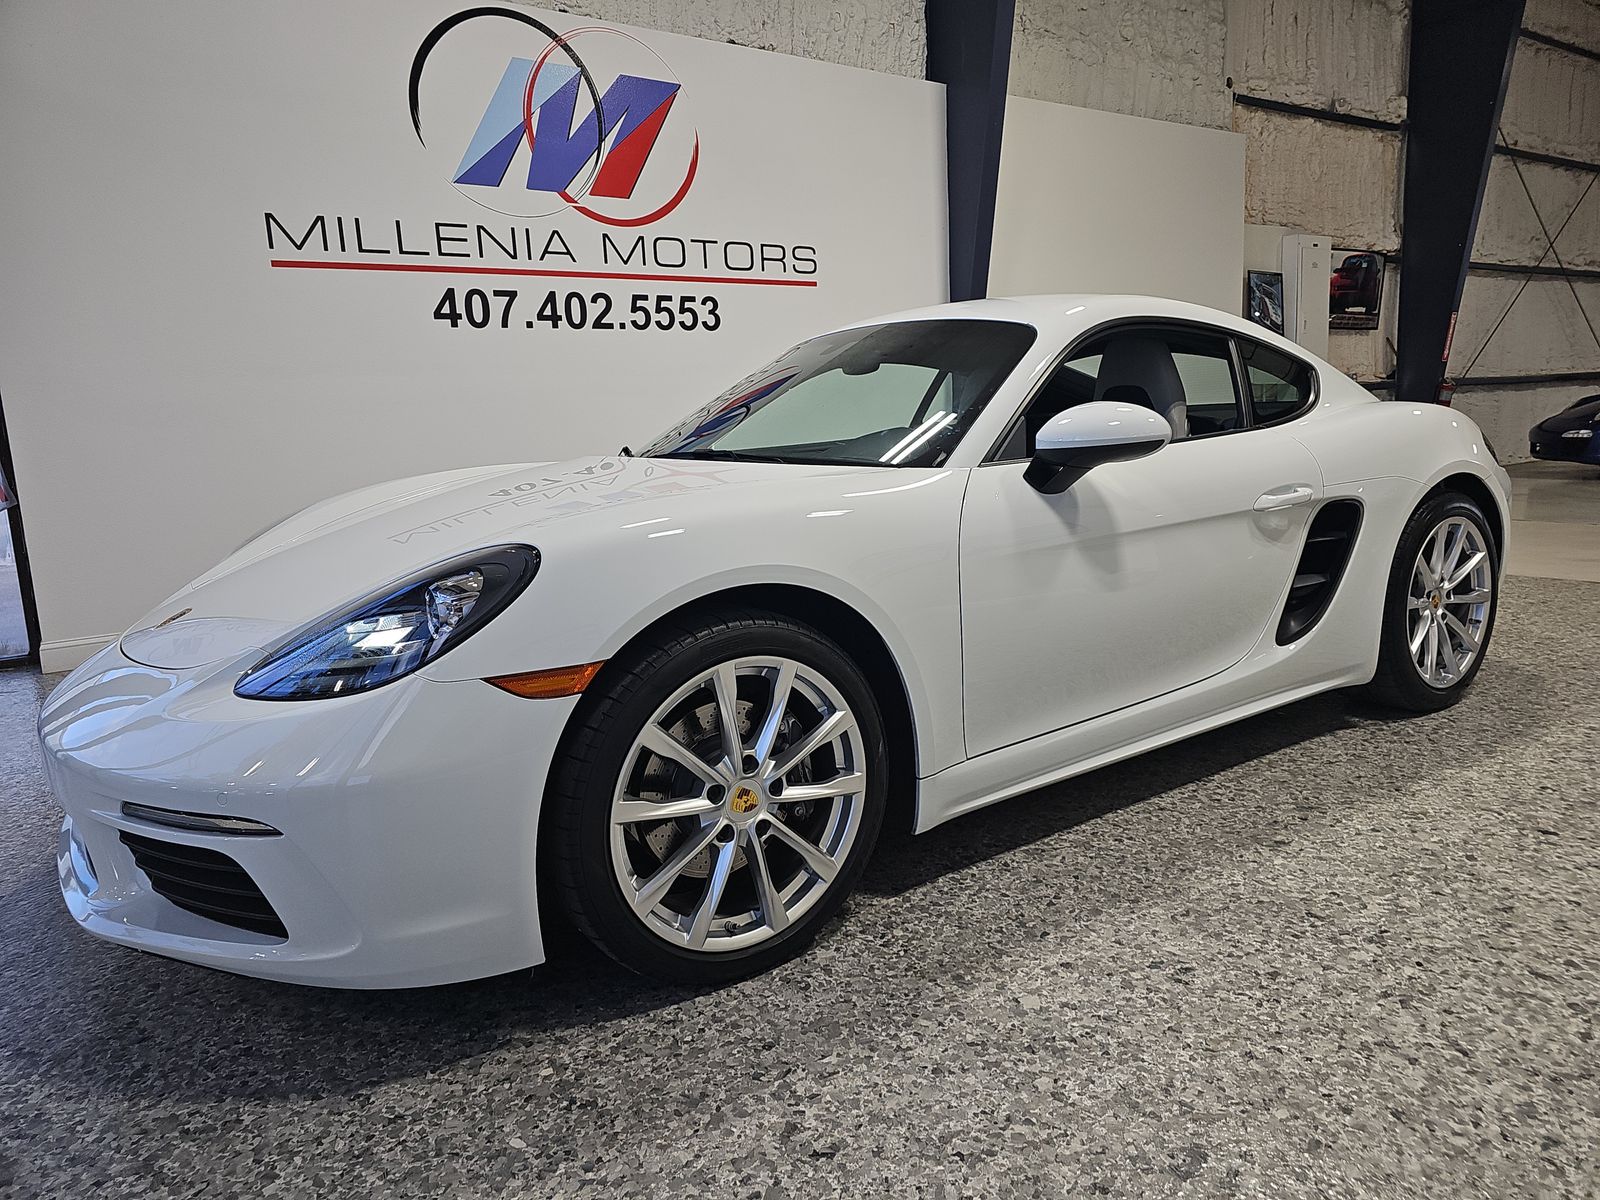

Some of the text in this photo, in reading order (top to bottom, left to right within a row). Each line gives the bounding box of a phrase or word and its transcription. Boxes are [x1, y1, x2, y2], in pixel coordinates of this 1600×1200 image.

[263, 212, 819, 276] MILLENIA MOTORS
[433, 287, 721, 332] 407.402.5553
